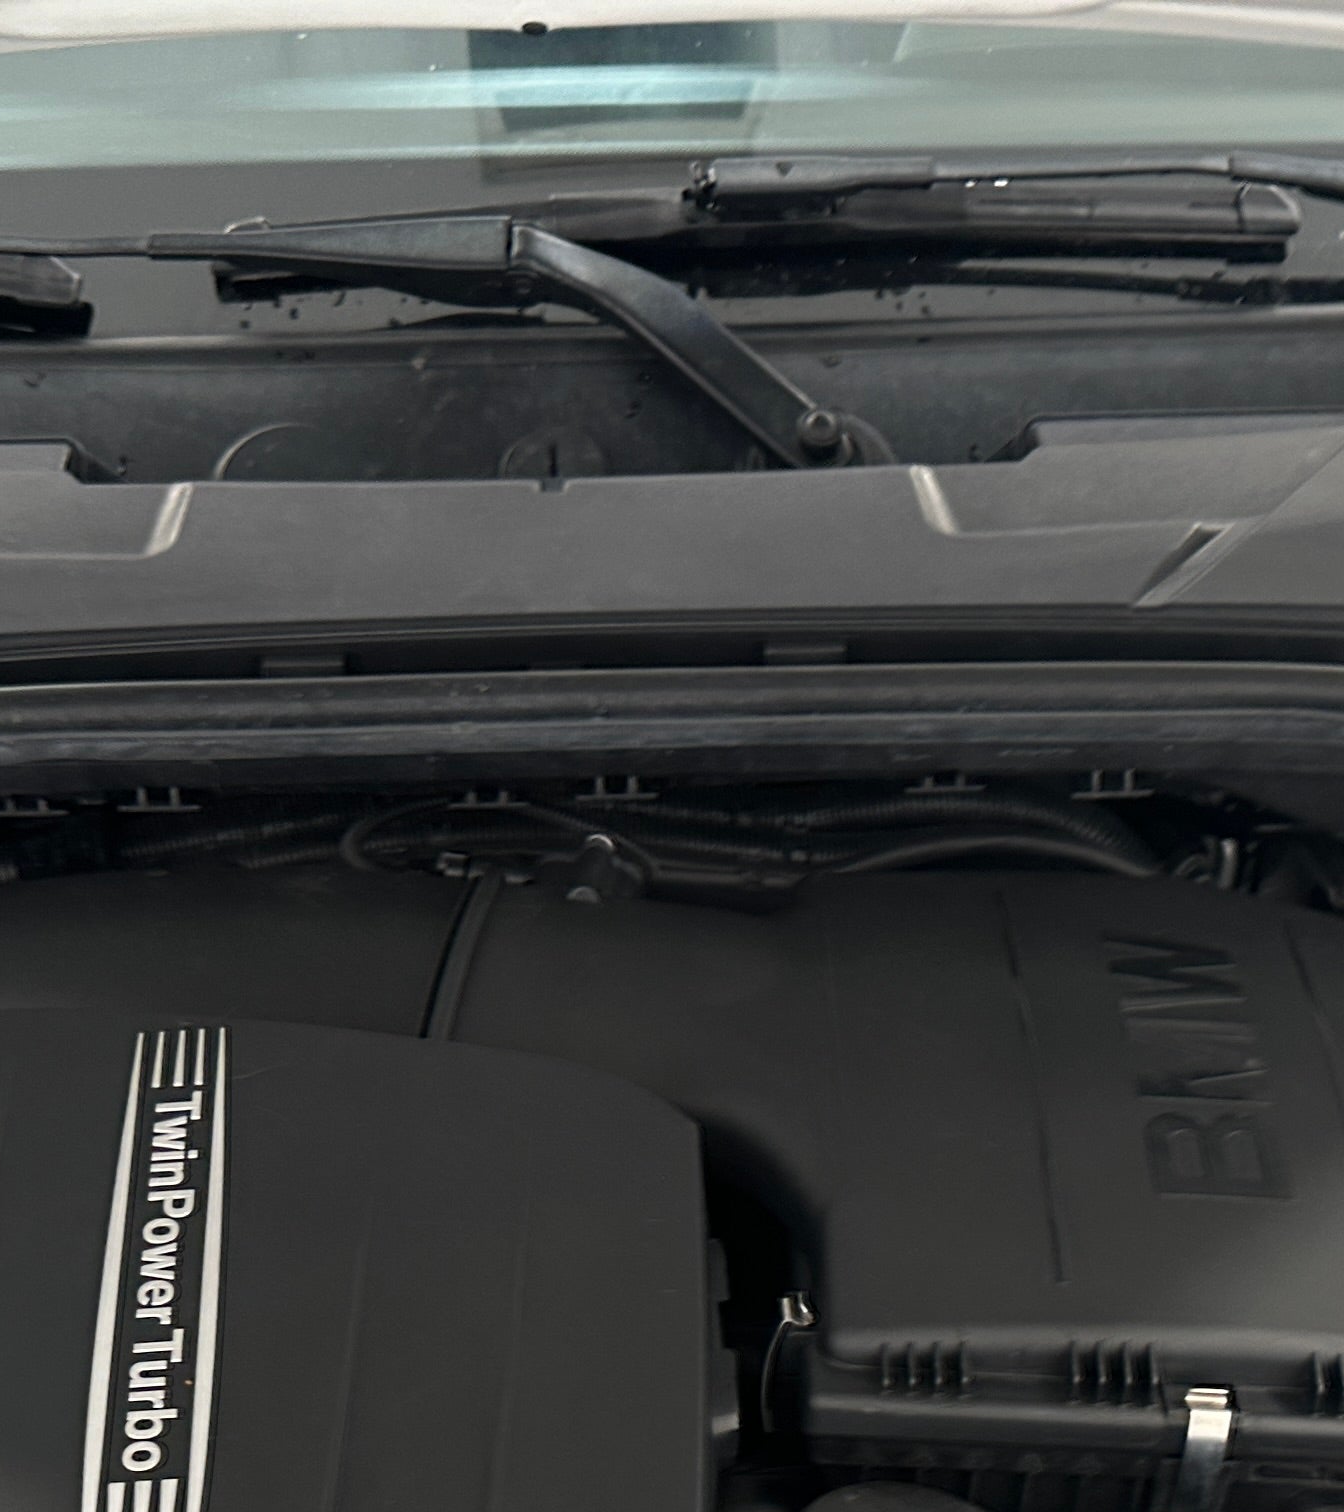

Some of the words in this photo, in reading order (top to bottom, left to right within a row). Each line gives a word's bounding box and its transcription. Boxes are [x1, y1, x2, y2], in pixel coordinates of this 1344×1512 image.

[1100, 930, 1296, 1200] BMW
[135, 1090, 205, 1326] TwinPower
[122, 1327, 183, 1473] Turbo
